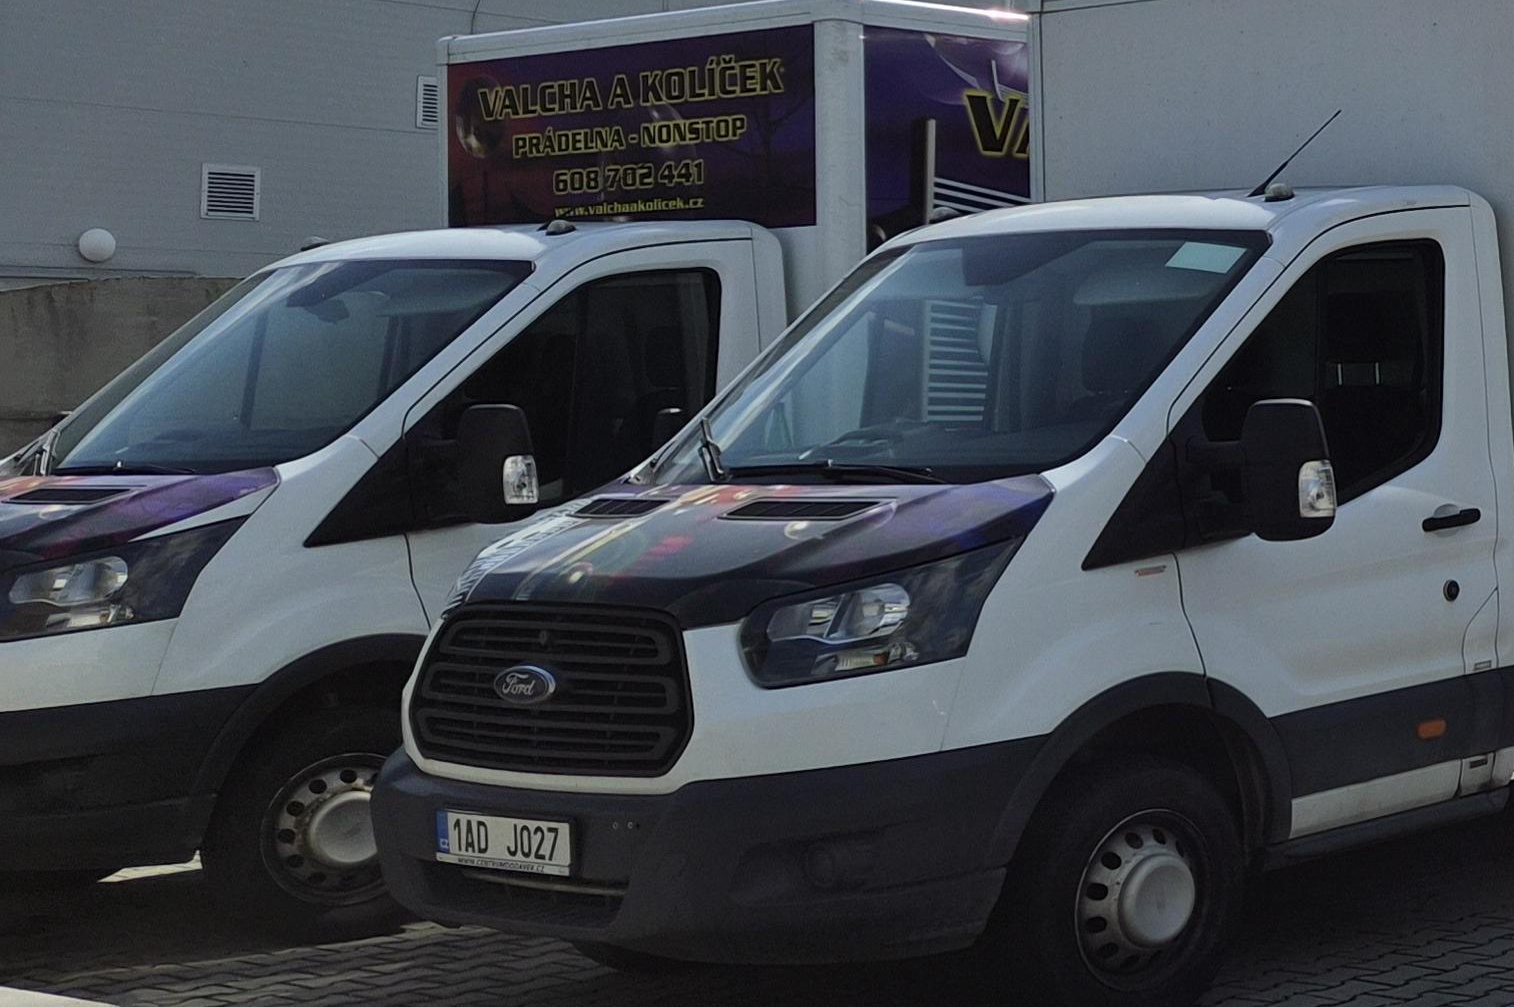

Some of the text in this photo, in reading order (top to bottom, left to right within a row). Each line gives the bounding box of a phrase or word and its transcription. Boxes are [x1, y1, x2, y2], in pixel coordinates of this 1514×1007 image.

[478, 56, 785, 123] VALCHA A KOLÍČEK
[513, 127, 626, 159] PRÁDELNA
[641, 115, 747, 148] NONSTOP
[554, 159, 704, 195] 608 702 441
[502, 673, 535, 695] Ford
[453, 818, 559, 862] 1AD J027
